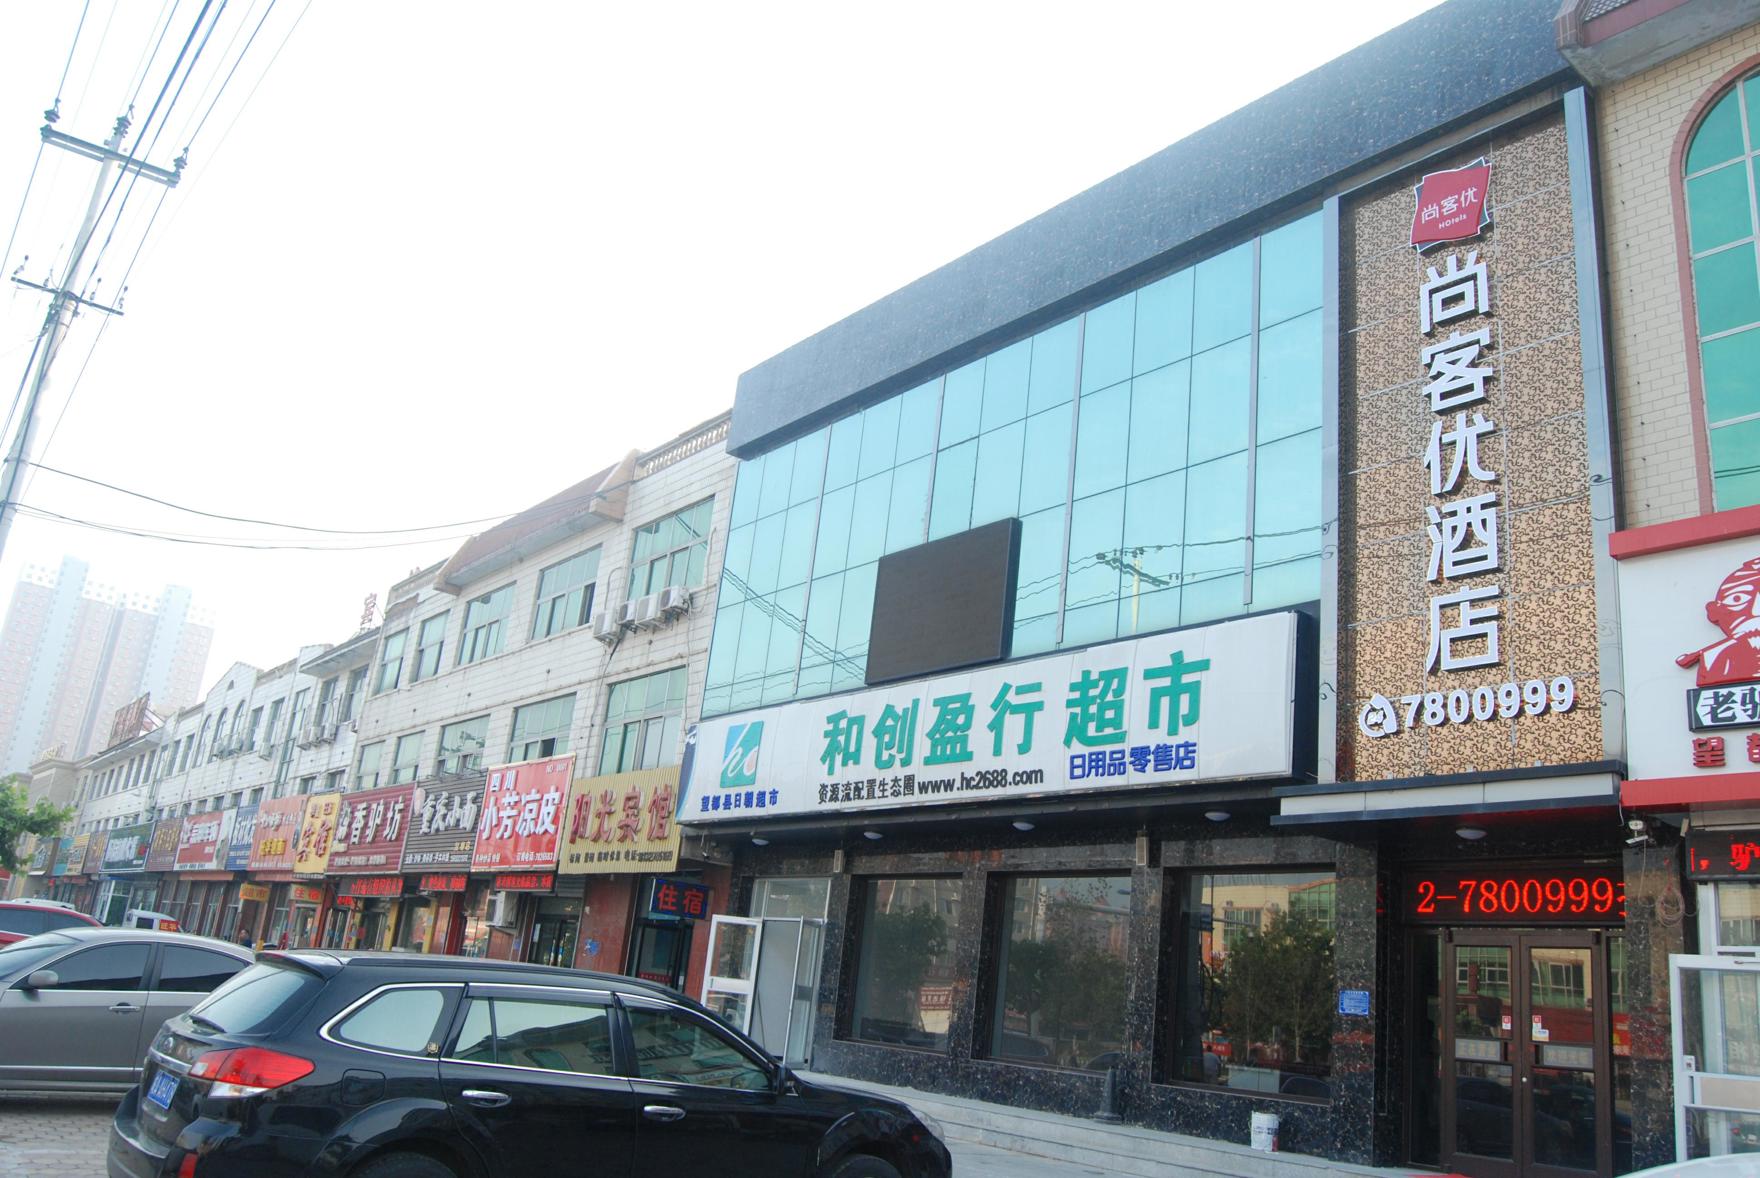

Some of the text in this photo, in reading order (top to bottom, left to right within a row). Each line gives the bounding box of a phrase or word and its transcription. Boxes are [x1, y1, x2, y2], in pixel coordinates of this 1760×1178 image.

[1421, 186, 1478, 224] 尚客优
[1420, 250, 1499, 673] 尚客优酒店
[1400, 676, 1574, 728] 7800999
[489, 769, 516, 792] 四川
[1069, 741, 1197, 780] 日用品零售店
[917, 768, 1044, 795] www.hc2688.com
[420, 790, 478, 834] 重庆小面
[480, 785, 561, 840] 小芳凉皮
[569, 783, 673, 844] 阳光宾馆
[657, 883, 705, 915] 住宿
